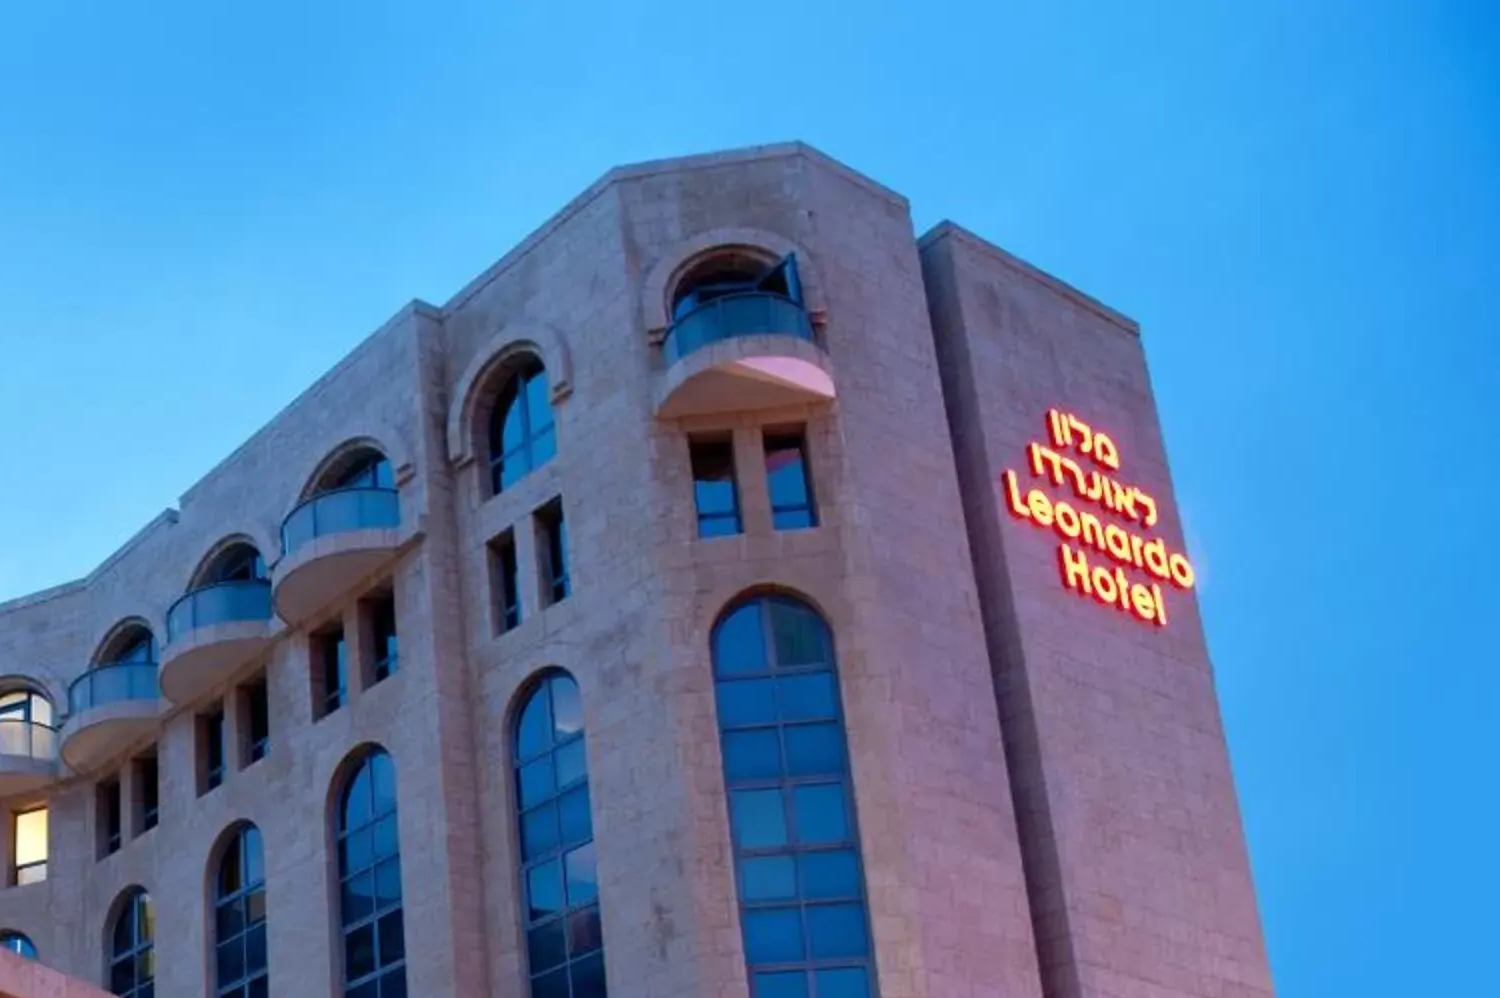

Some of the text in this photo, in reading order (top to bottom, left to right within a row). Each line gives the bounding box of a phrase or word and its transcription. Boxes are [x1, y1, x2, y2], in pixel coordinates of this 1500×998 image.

[1046, 408, 1119, 470] מלון
[1027, 442, 1157, 527] לאונרדו
[1003, 469, 1194, 588] Leonardo
[1060, 543, 1166, 627] Hotel
